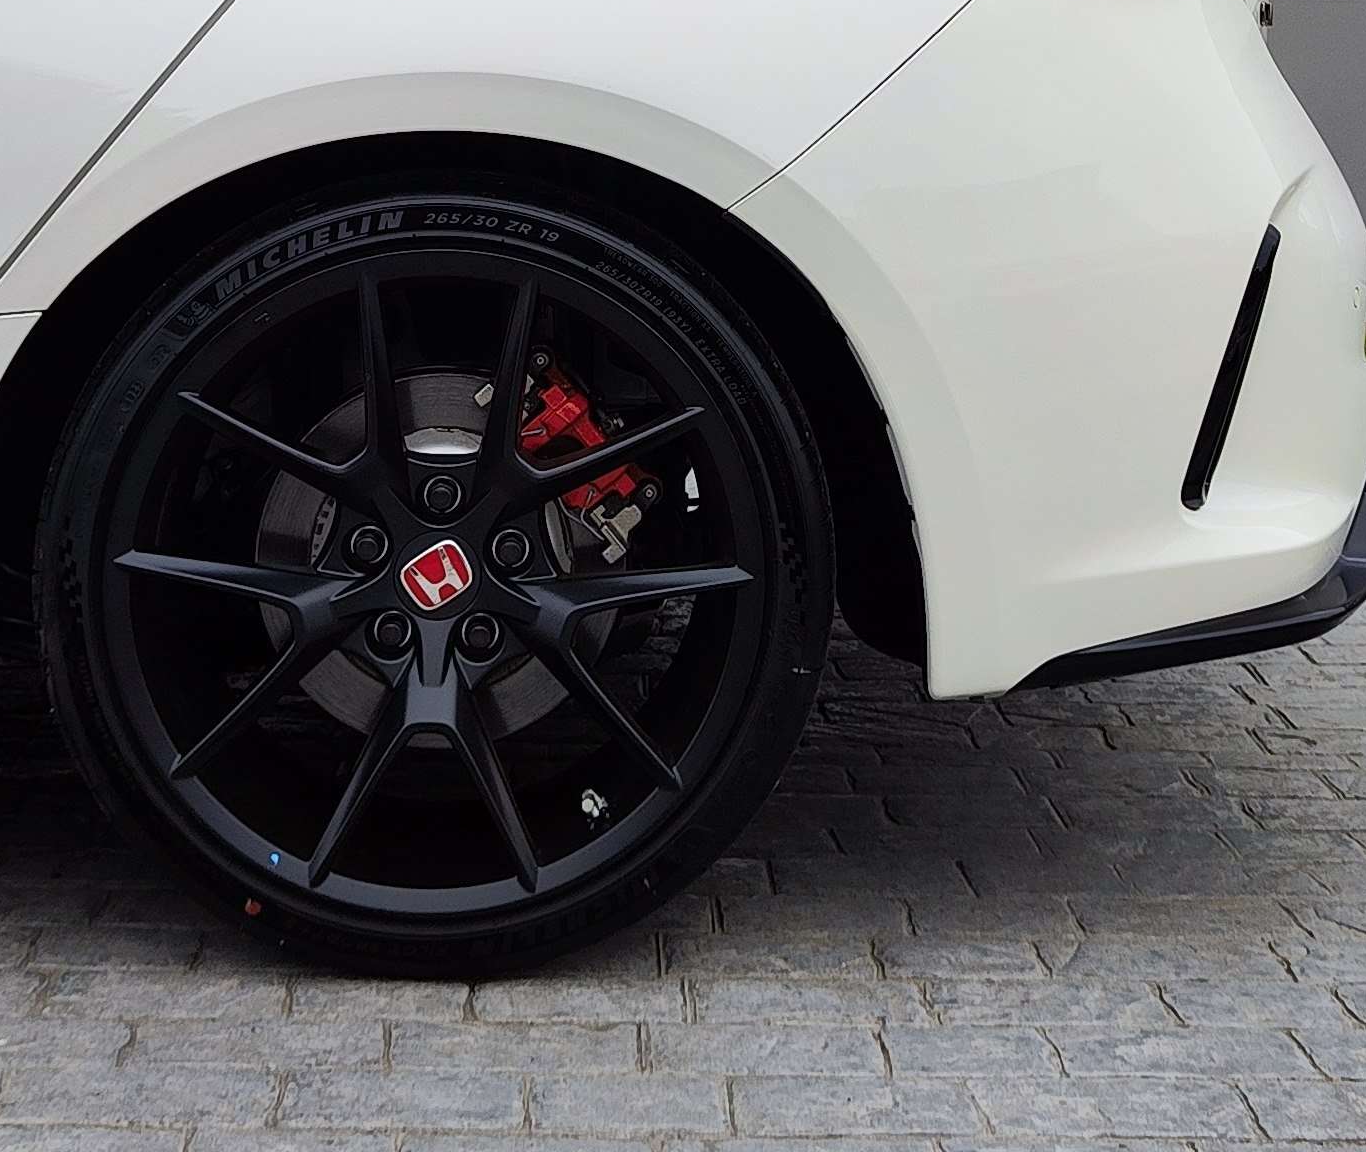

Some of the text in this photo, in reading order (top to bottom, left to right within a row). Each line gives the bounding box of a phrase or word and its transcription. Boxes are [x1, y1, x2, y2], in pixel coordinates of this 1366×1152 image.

[216, 211, 404, 300] MICHELIN
[423, 212, 561, 243] 265/30 ZR 19
